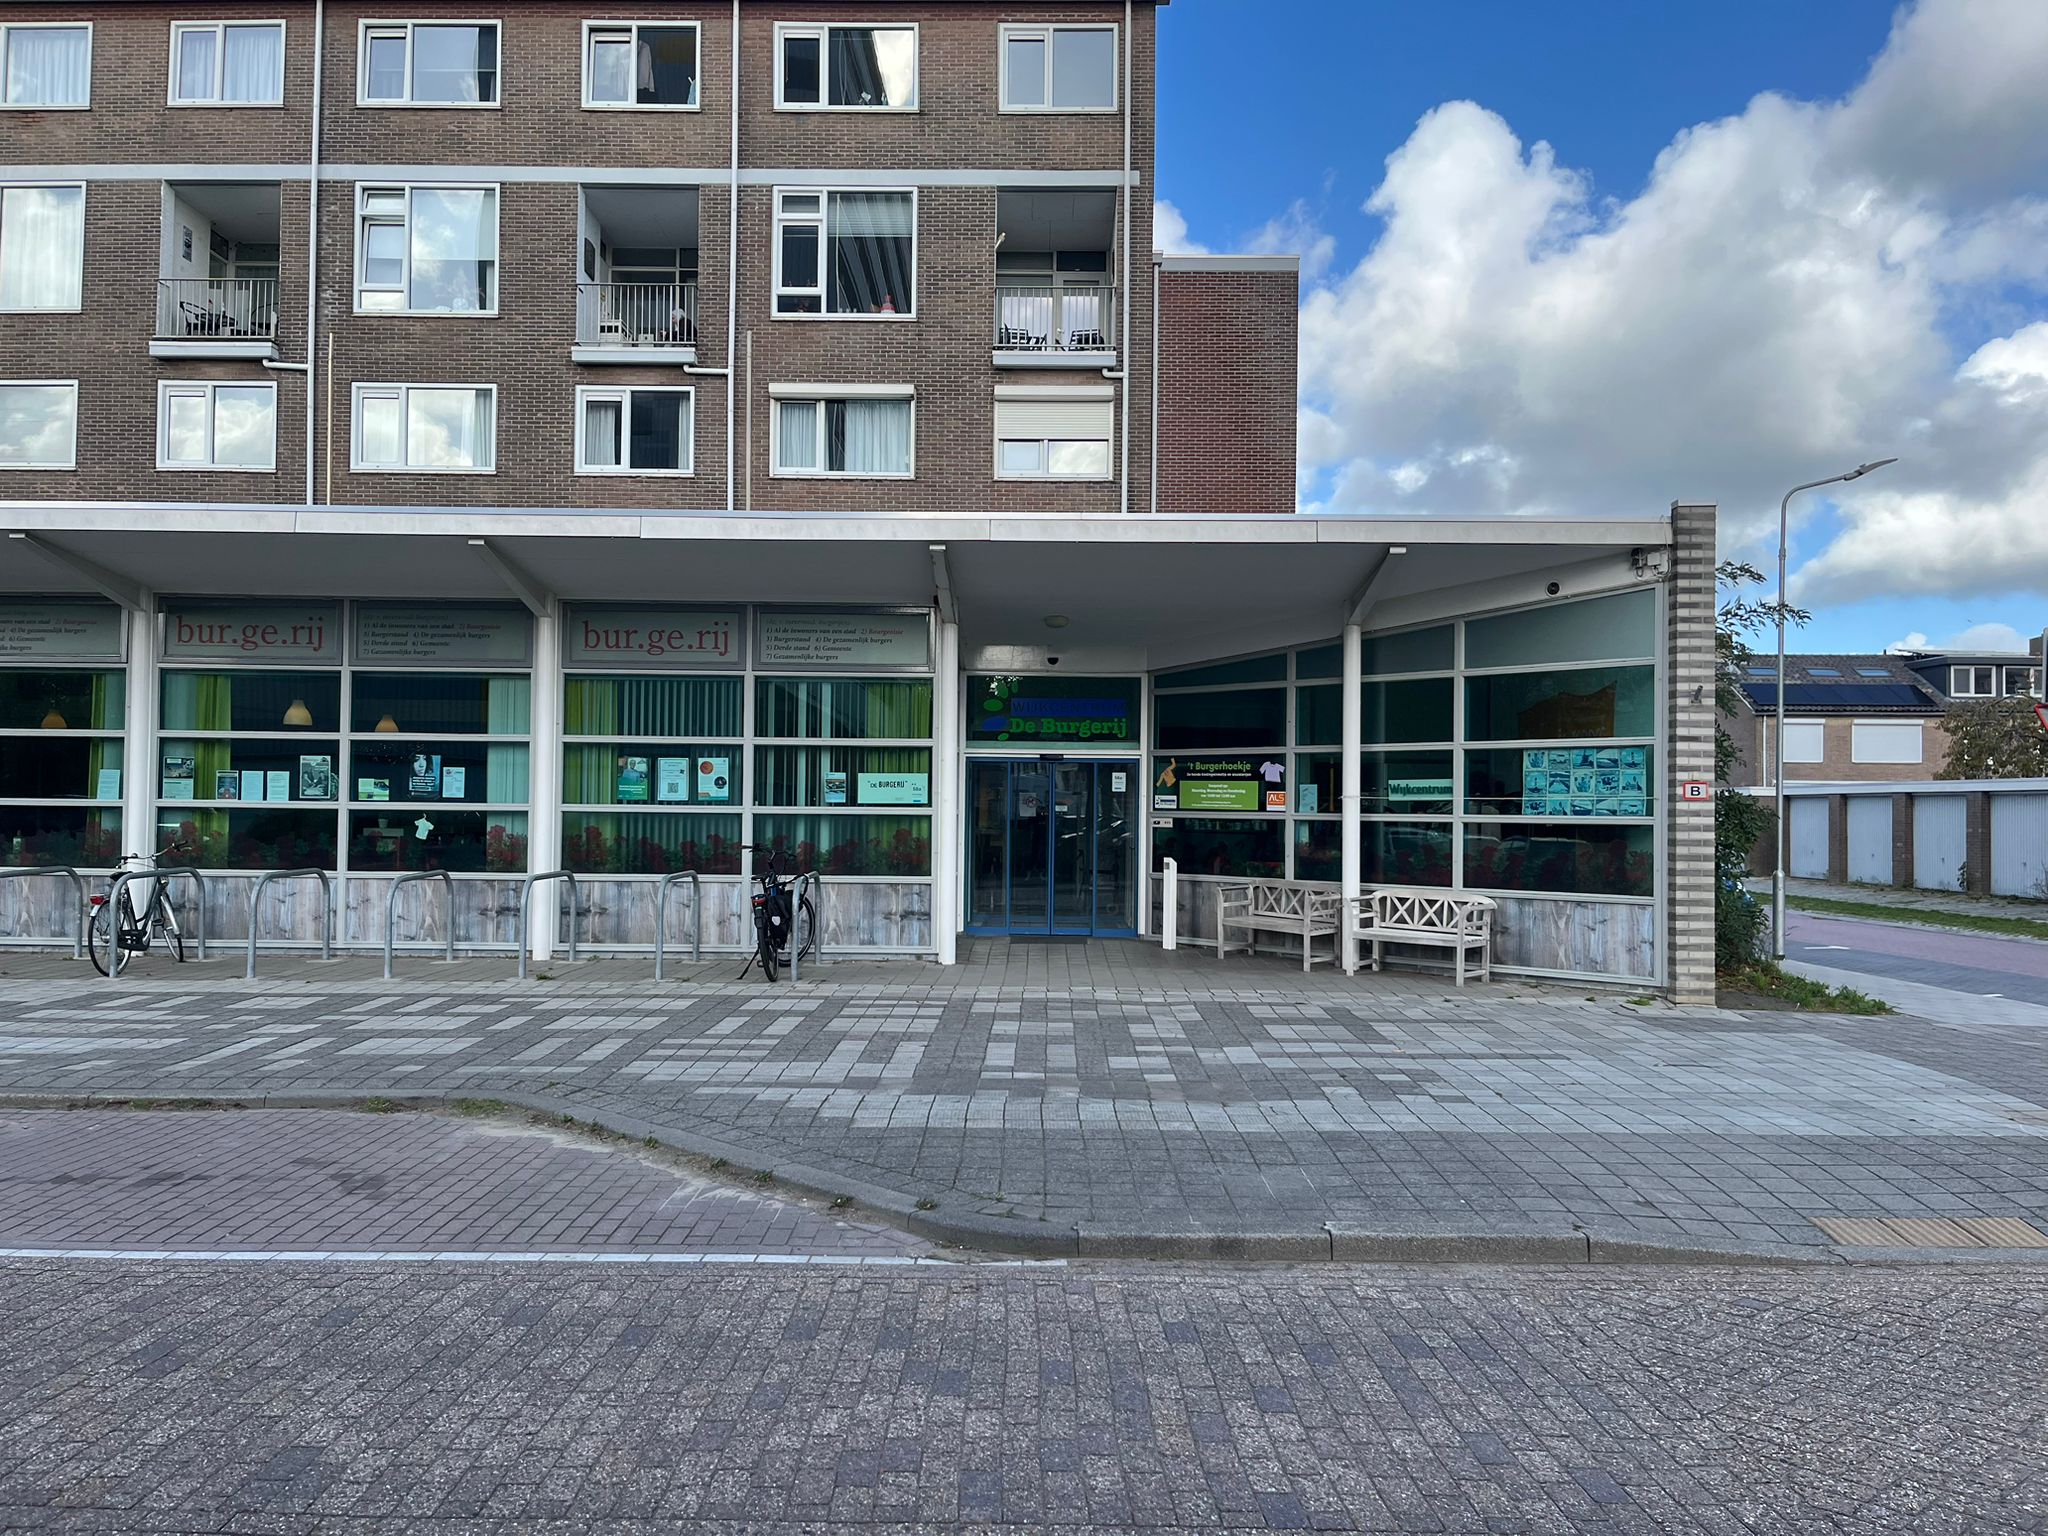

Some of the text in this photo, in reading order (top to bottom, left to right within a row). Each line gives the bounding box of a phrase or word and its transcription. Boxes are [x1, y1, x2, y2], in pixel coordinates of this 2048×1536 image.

[176, 615, 325, 651] bur.ge.rij
[582, 620, 729, 656] bur.ge.rij
[1009, 717, 1128, 738] De Burgerij
[1195, 761, 1251, 772] Burgerhoekje
[1389, 783, 1453, 797] Wijkcentrum
[1690, 786, 1701, 797] B
[1268, 793, 1285, 802] ALS
